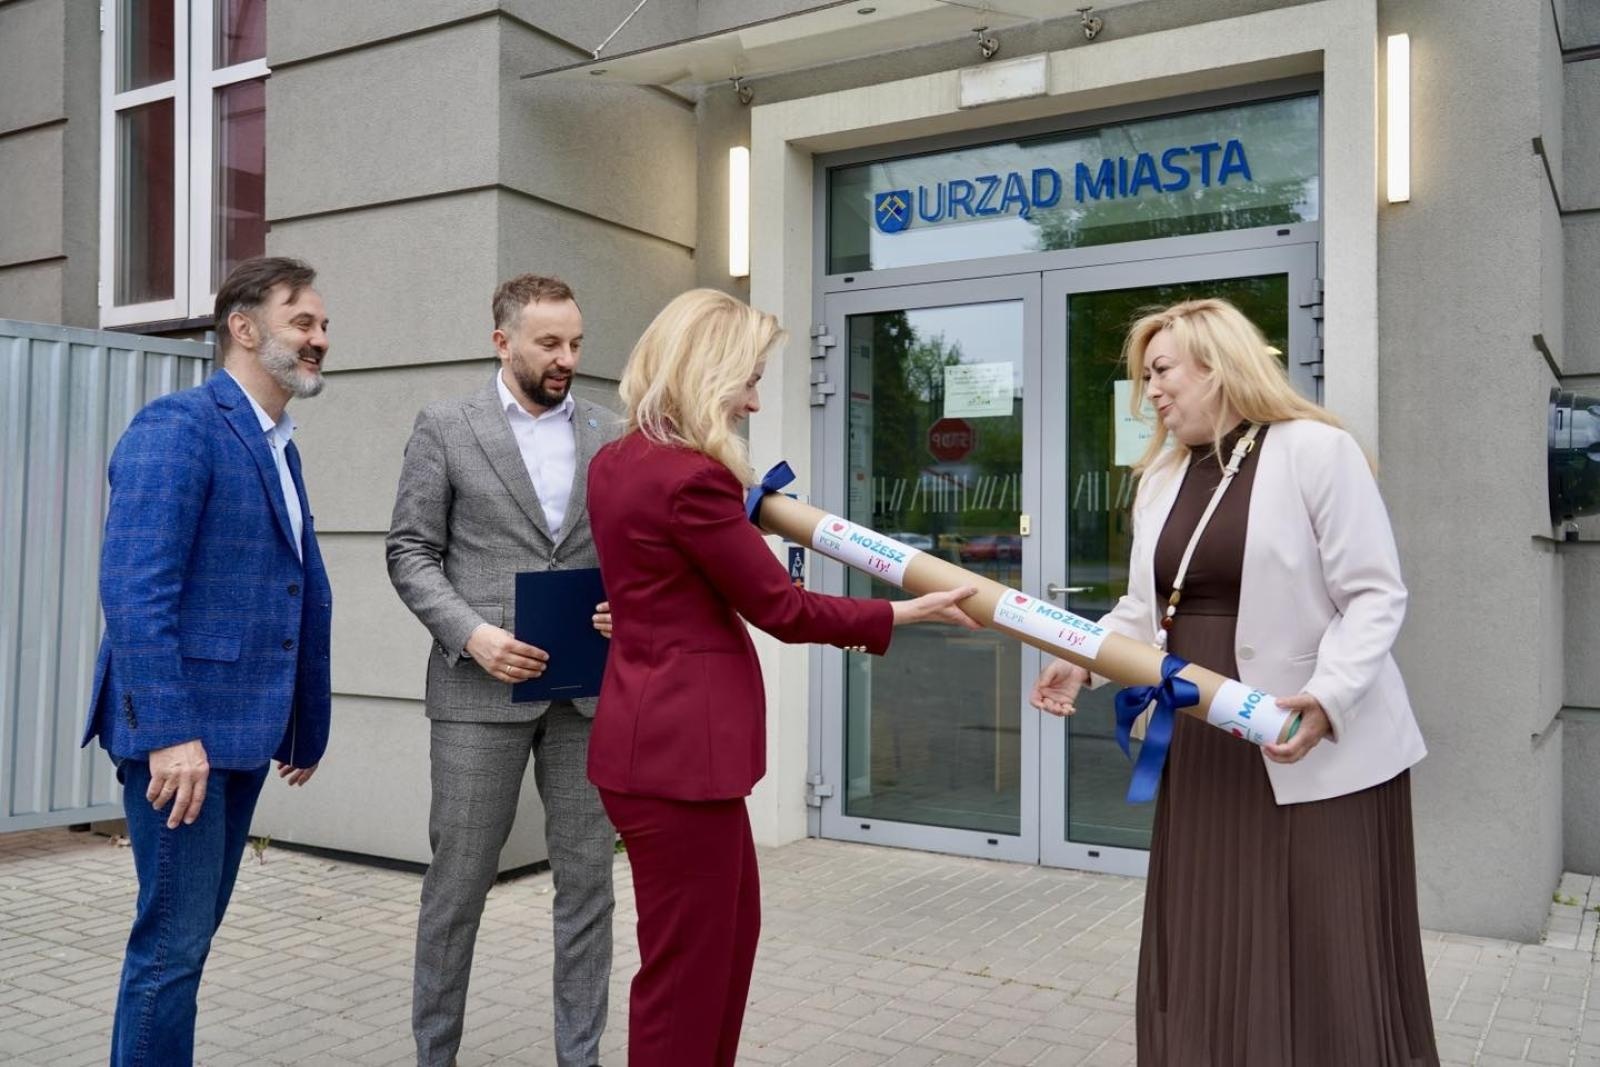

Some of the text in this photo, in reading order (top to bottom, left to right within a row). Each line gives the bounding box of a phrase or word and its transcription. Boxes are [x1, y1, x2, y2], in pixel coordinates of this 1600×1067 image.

[918, 139, 1252, 220] URZĄD MIASTA
[850, 532, 906, 563] MOŻESZ
[875, 557, 891, 573] Ty!
[1036, 605, 1105, 636] MOŻESZ
[1067, 630, 1087, 647] Ty!
